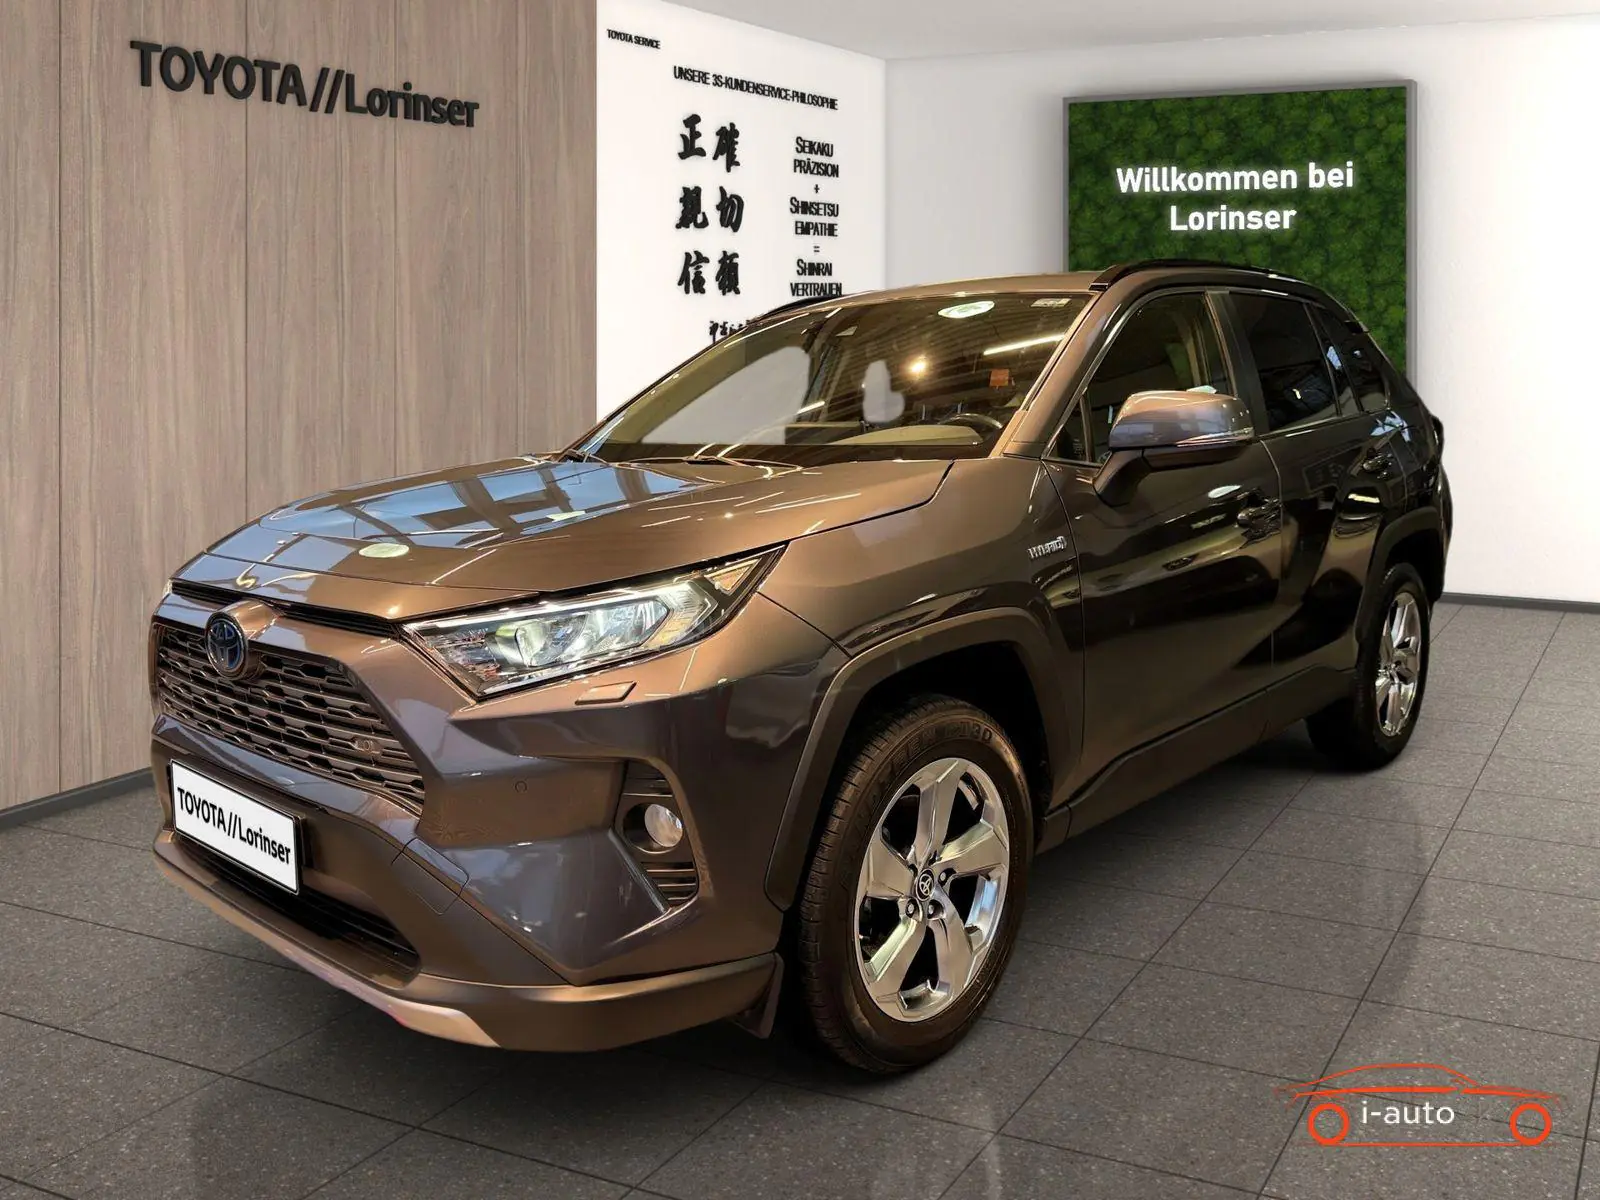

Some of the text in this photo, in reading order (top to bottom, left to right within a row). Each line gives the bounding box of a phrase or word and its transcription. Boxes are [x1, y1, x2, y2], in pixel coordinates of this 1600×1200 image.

[606, 28, 661, 50] TOYOTA SERVICE
[673, 65, 839, 111] UNSERE 3S-KUNDENSERVICE-PHILOSOPHIE
[795, 136, 834, 157] SEIKAKU
[793, 158, 840, 178] PRÄZISION
[1116, 161, 1354, 193] Willkommen bei
[789, 196, 840, 218] SHINSETSU
[1170, 204, 1297, 231] Lorinser
[794, 220, 839, 238] EMPATHIE
[796, 258, 833, 277] SHINRAI
[789, 282, 843, 297] VERTRAUEN
